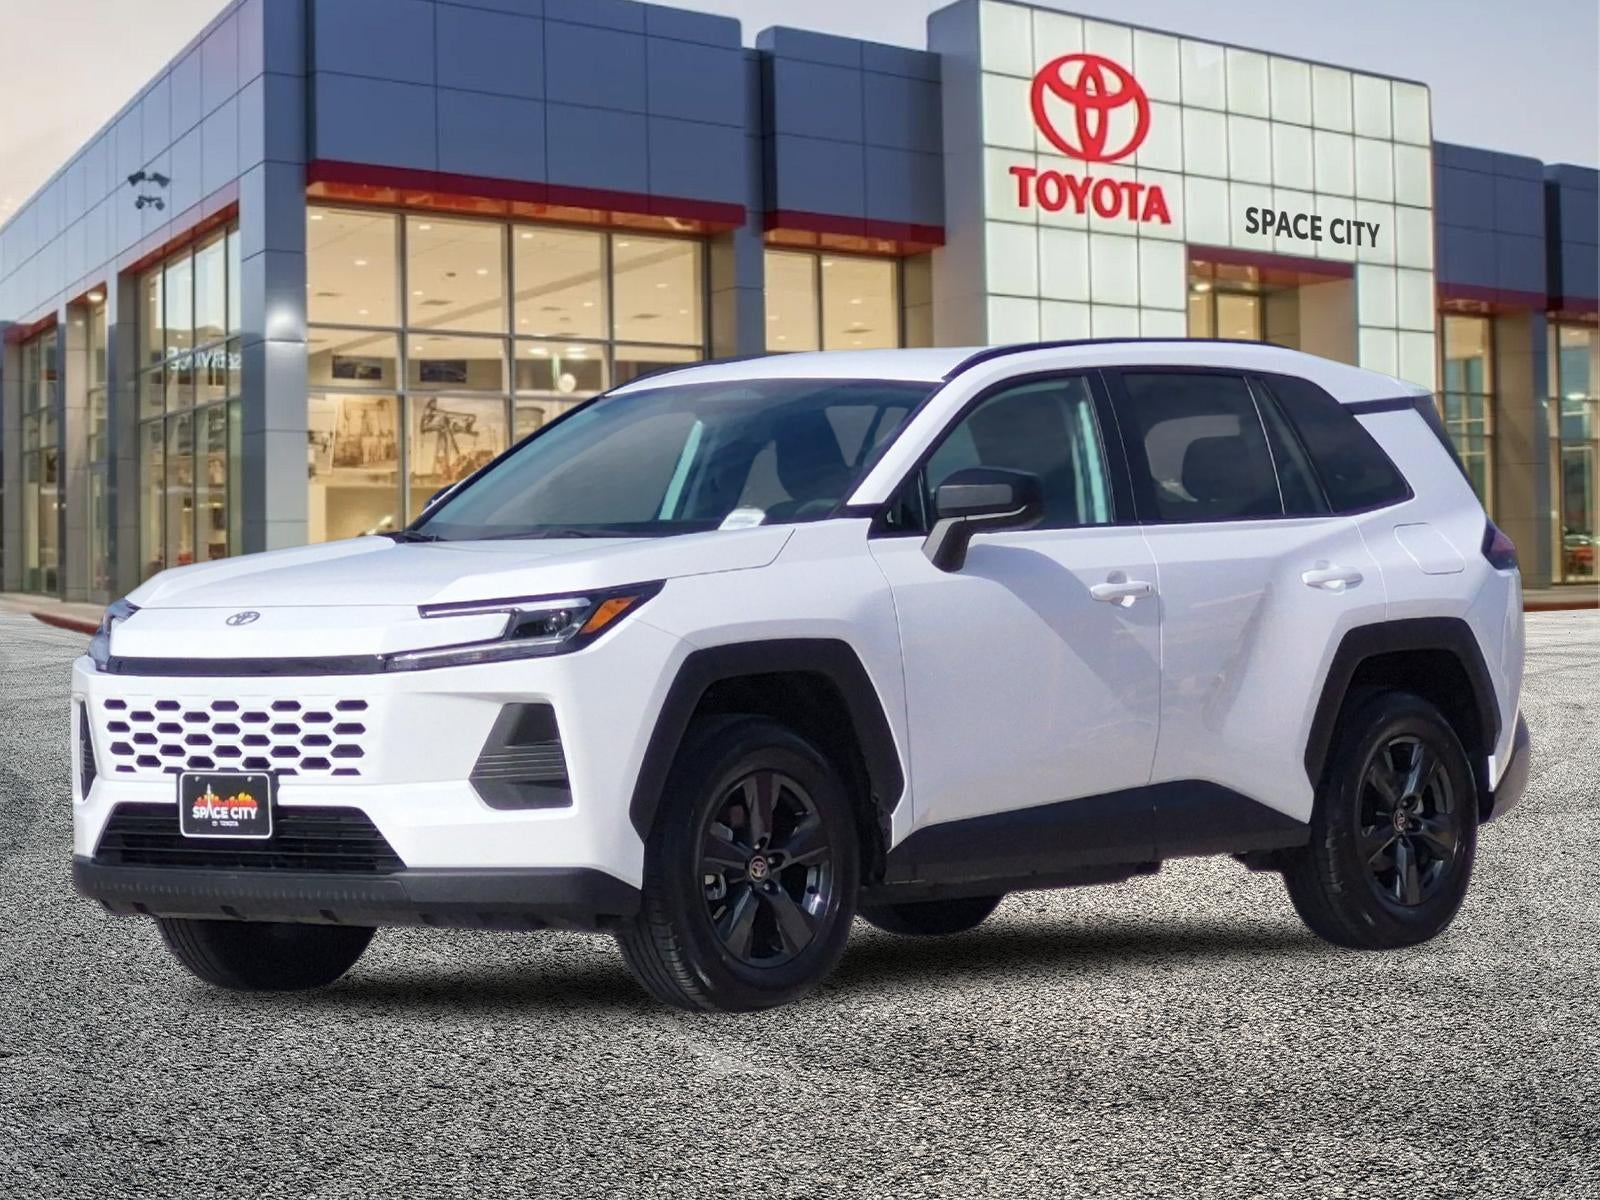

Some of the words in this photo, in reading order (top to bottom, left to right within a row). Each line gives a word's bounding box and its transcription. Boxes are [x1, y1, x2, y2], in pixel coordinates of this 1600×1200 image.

[1009, 166, 1171, 224] TOYOTA
[1245, 206, 1323, 242] SPACE
[1329, 218, 1381, 248] CITY
[192, 805, 229, 819] SPACE
[230, 806, 258, 820] CITY
